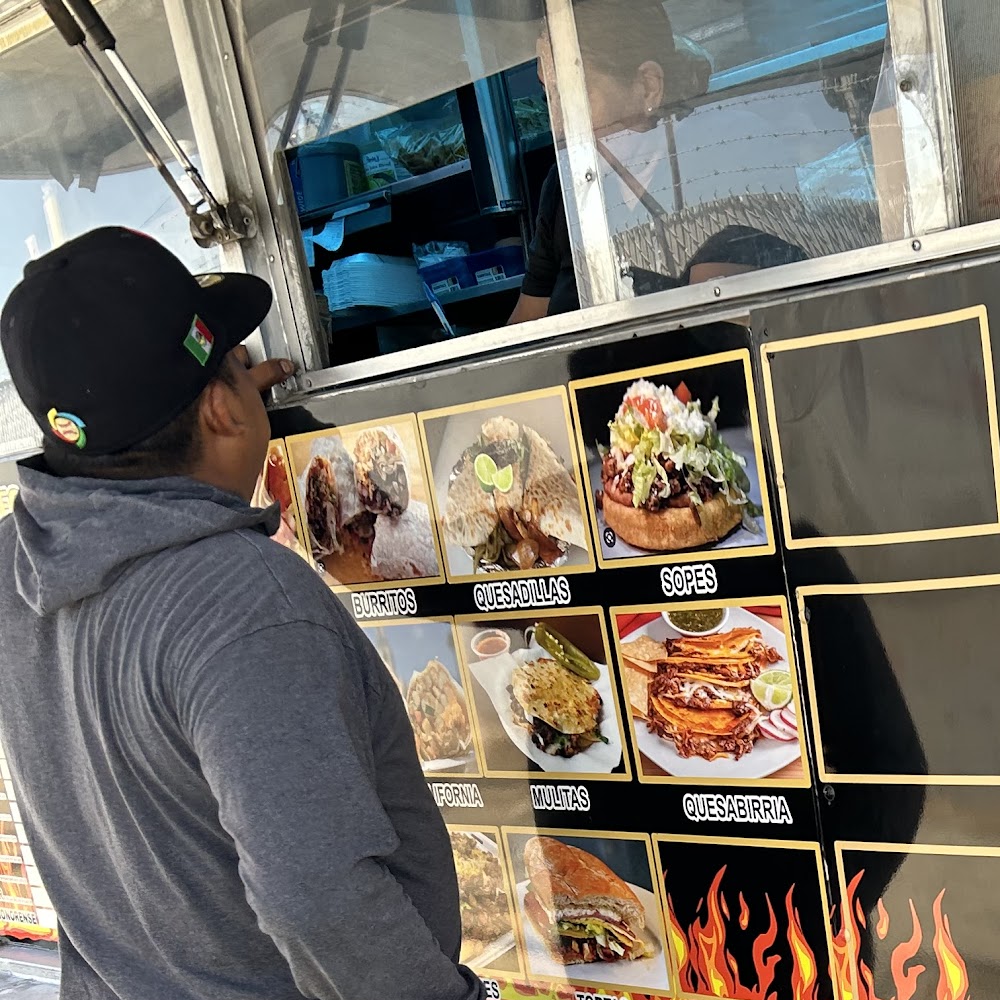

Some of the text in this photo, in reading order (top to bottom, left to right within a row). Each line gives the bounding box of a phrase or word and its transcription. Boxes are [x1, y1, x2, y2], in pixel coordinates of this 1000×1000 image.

[473, 576, 571, 612] QUESADILLAS
[660, 563, 717, 596] SOPES
[351, 588, 417, 619] BURRITOS
[427, 782, 484, 807] IFORNIA
[530, 784, 591, 811] MULITAS
[683, 793, 793, 824] QUESABIRRIA
